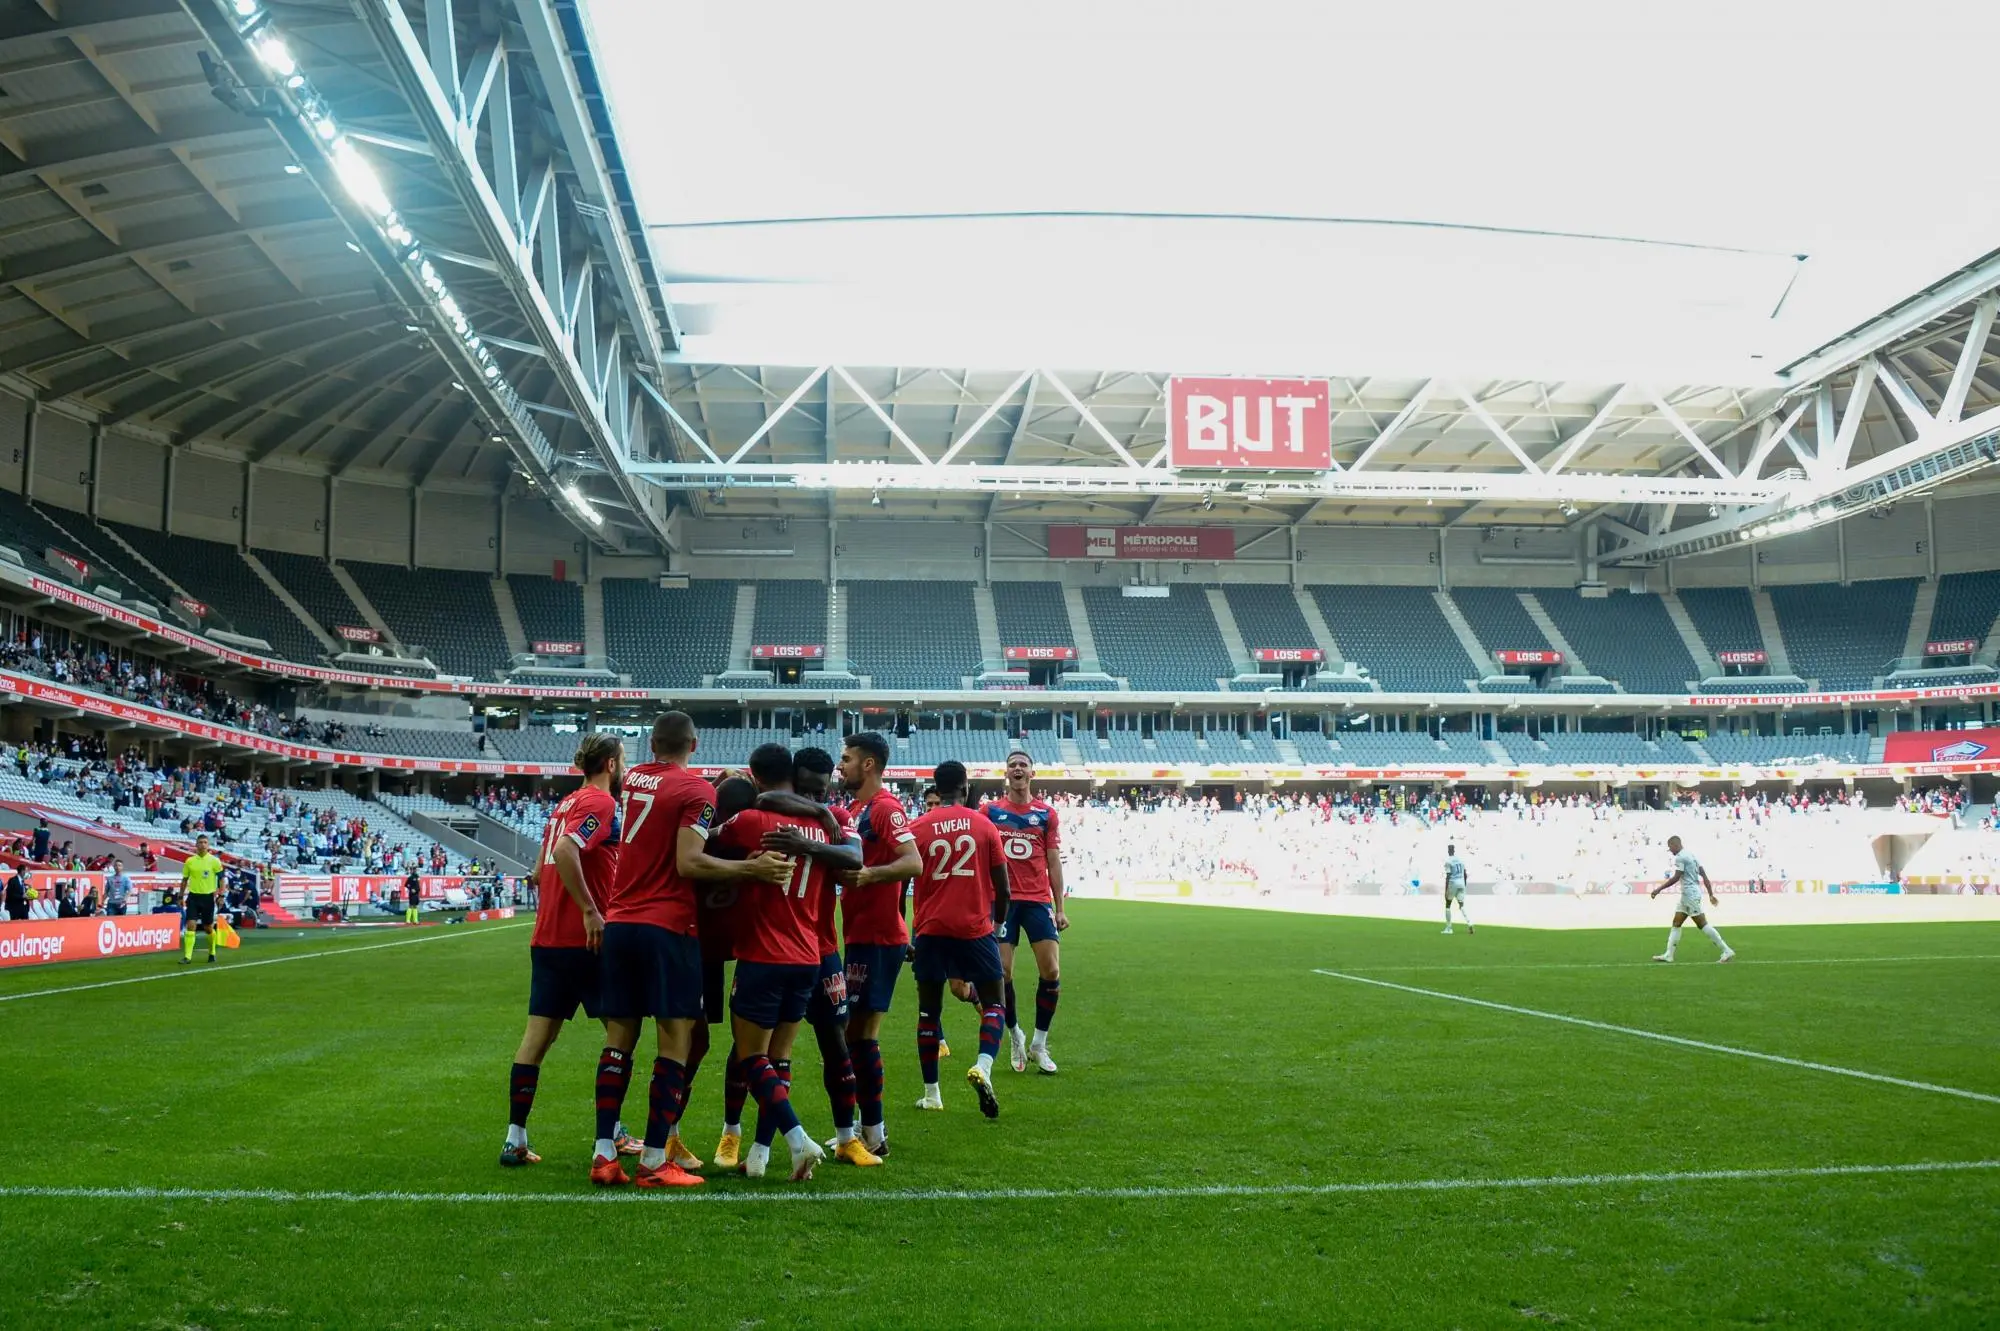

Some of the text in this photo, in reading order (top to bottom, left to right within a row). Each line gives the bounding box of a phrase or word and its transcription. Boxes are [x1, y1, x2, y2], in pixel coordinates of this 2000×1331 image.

[1187, 395, 1316, 453] BUT
[1087, 535, 1116, 549] MEL
[1123, 533, 1198, 546] MÉTROPOLE
[343, 627, 371, 640] LOSC
[545, 643, 573, 653] LOSC
[773, 645, 802, 656] LOSC
[1026, 647, 1054, 657] LOSC
[1937, 642, 1966, 653] LOSC
[1273, 649, 1301, 660] LOSC
[1517, 652, 1543, 662] LOSC
[1727, 651, 1756, 663] LOSC
[269, 663, 311, 677] MÉTROPOLE
[372, 677, 385, 686] DE
[389, 679, 416, 688] LILLE
[464, 685, 523, 695] MÉTROPOLE
[600, 690, 613, 698] DE
[619, 690, 648, 698] LILLE
[476, 763, 505, 773] WINAMAX
[539, 765, 570, 775] WINAMAX
[626, 772, 663, 790] BURAK
[620, 790, 655, 844] 17
[932, 818, 970, 836] T.WEAH
[999, 830, 1038, 841] boulanger
[928, 834, 976, 881] 22
[117, 926, 174, 950] boulanger
